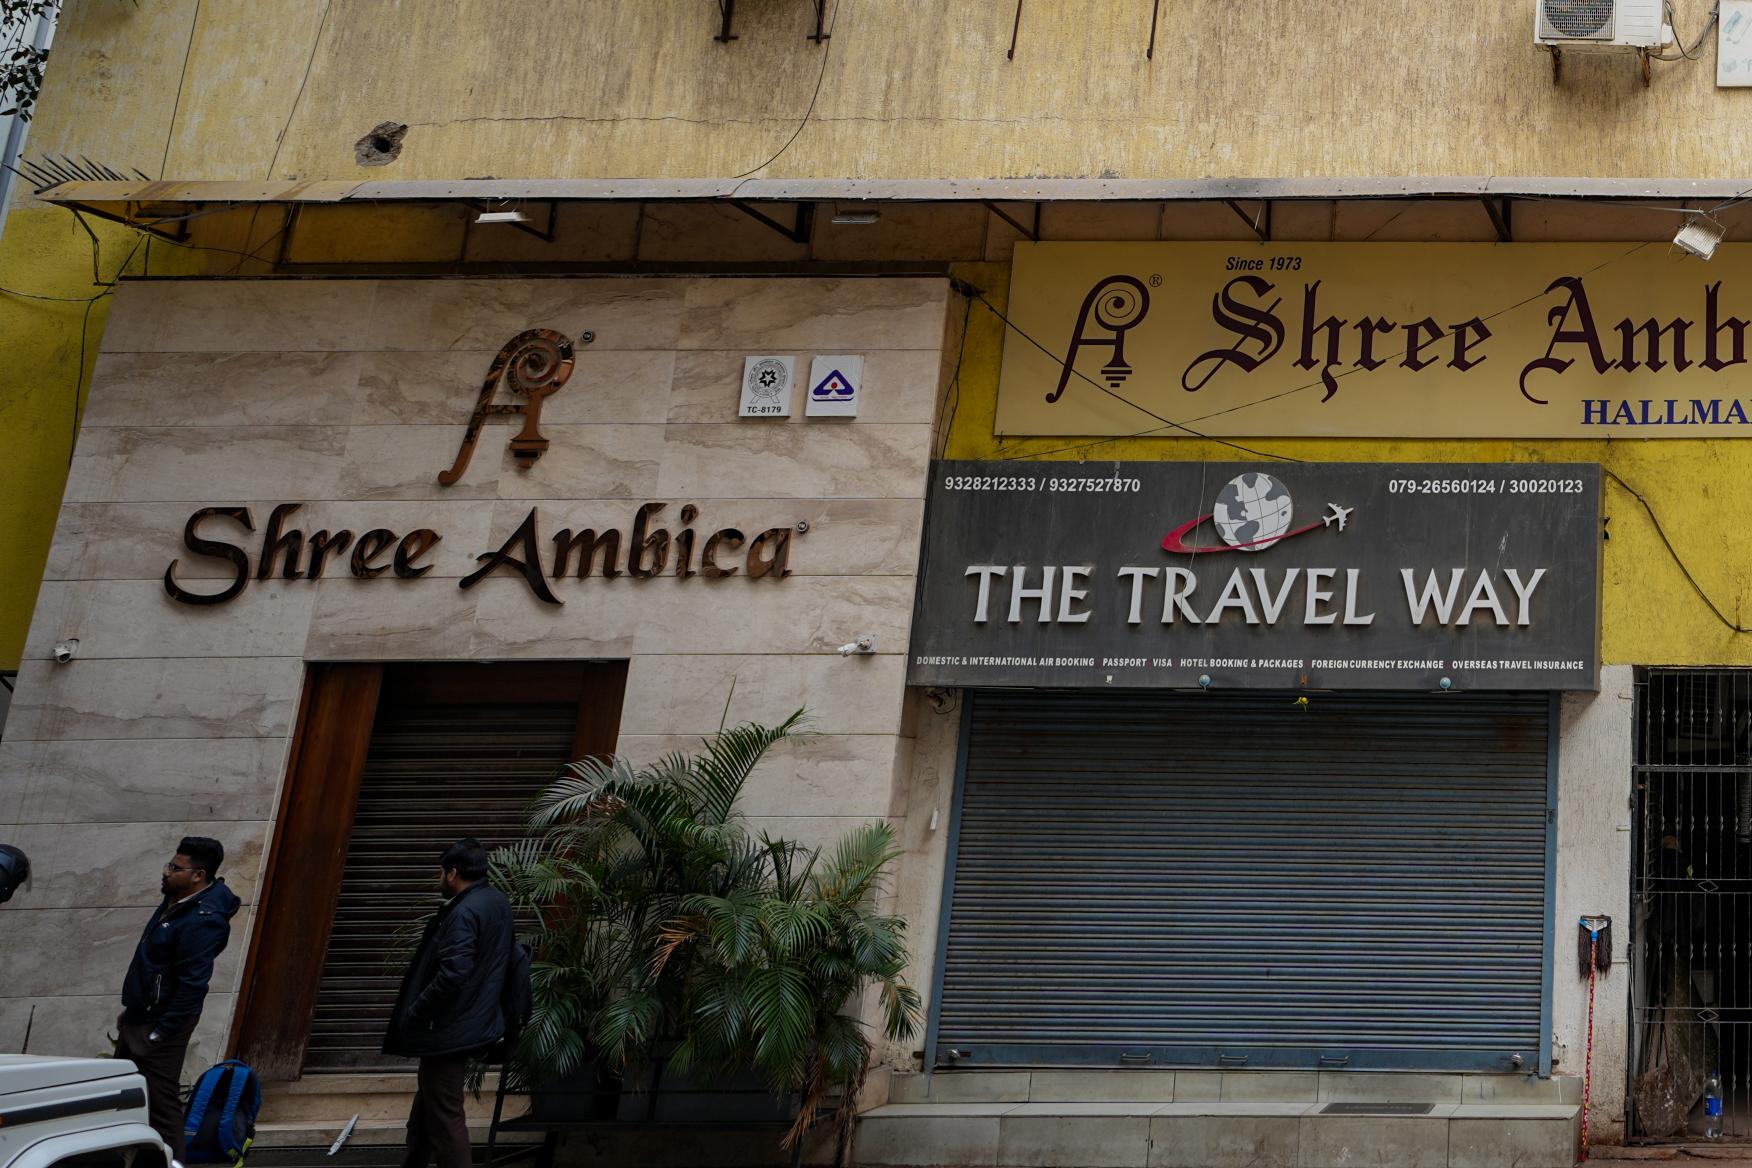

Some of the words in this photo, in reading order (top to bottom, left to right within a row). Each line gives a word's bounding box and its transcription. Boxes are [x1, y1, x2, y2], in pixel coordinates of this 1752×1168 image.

[1225, 257, 1263, 271] Since
[1269, 257, 1302, 271] 1973
[1182, 275, 1492, 404] Shree
[747, 406, 782, 414] TC-8179
[944, 477, 1036, 491] 9328212333
[1049, 478, 1141, 492] 9327527870
[1389, 479, 1495, 493] 079-26560124
[1510, 479, 1584, 493] 30020123
[164, 503, 443, 606] Shree
[458, 502, 795, 607] Ambica
[964, 565, 1093, 624] THE
[1117, 566, 1375, 626] TRAVEL
[1400, 567, 1548, 627] WAY
[916, 657, 960, 665] DOMESTIC
[969, 657, 1037, 666] INTERNATIONAL
[1039, 658, 1054, 666] AIR
[1055, 658, 1095, 666] BOOKING
[1102, 658, 1147, 667] PASSPORT
[1152, 659, 1172, 667] VISA
[1180, 659, 1208, 667] HOTEL
[1210, 659, 1248, 668] BOOKING
[1258, 659, 1304, 668] PACKAGES
[1311, 660, 1349, 669] FOREIGN
[1349, 660, 1396, 669] CURRENCY
[1397, 660, 1444, 669] EXCHANGE
[1452, 660, 1498, 669] OVERSEAS
[1499, 661, 1532, 670] TRAVEL
[1533, 661, 1584, 670] INSURANCE
